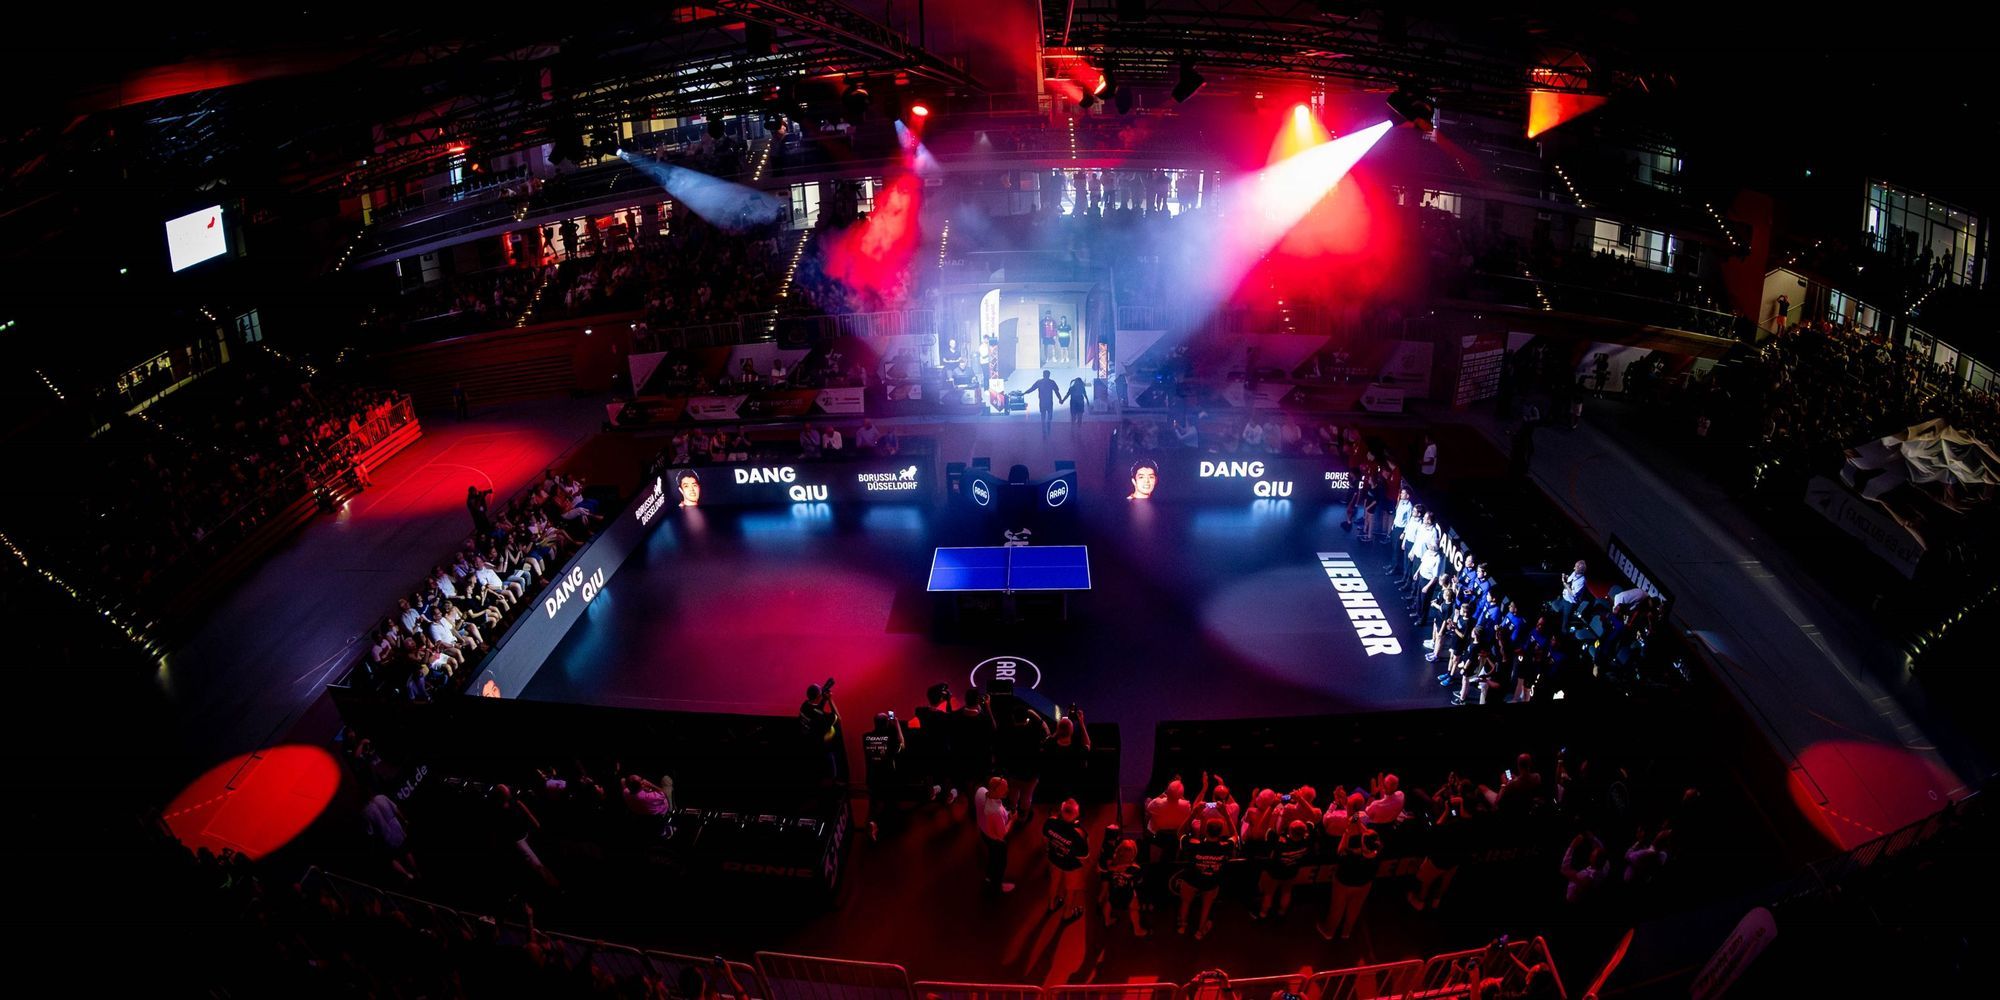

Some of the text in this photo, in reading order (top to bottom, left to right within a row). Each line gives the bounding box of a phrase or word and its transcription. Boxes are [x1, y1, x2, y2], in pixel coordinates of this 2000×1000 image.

[734, 467, 796, 484] DANG
[858, 473, 898, 482] BORUSSIA
[1199, 461, 1265, 478] DANG
[1324, 471, 1350, 481] BORUS
[788, 484, 828, 502] QIU
[867, 480, 918, 491] DÜSSELDORF
[974, 486, 988, 499] ARAG
[1049, 486, 1066, 499] ARAG
[1253, 481, 1294, 498] QIU
[545, 565, 584, 619] DANG
[581, 567, 605, 603] QIU
[1316, 552, 1403, 657] LIEBHERR
[995, 661, 1017, 683] AR
